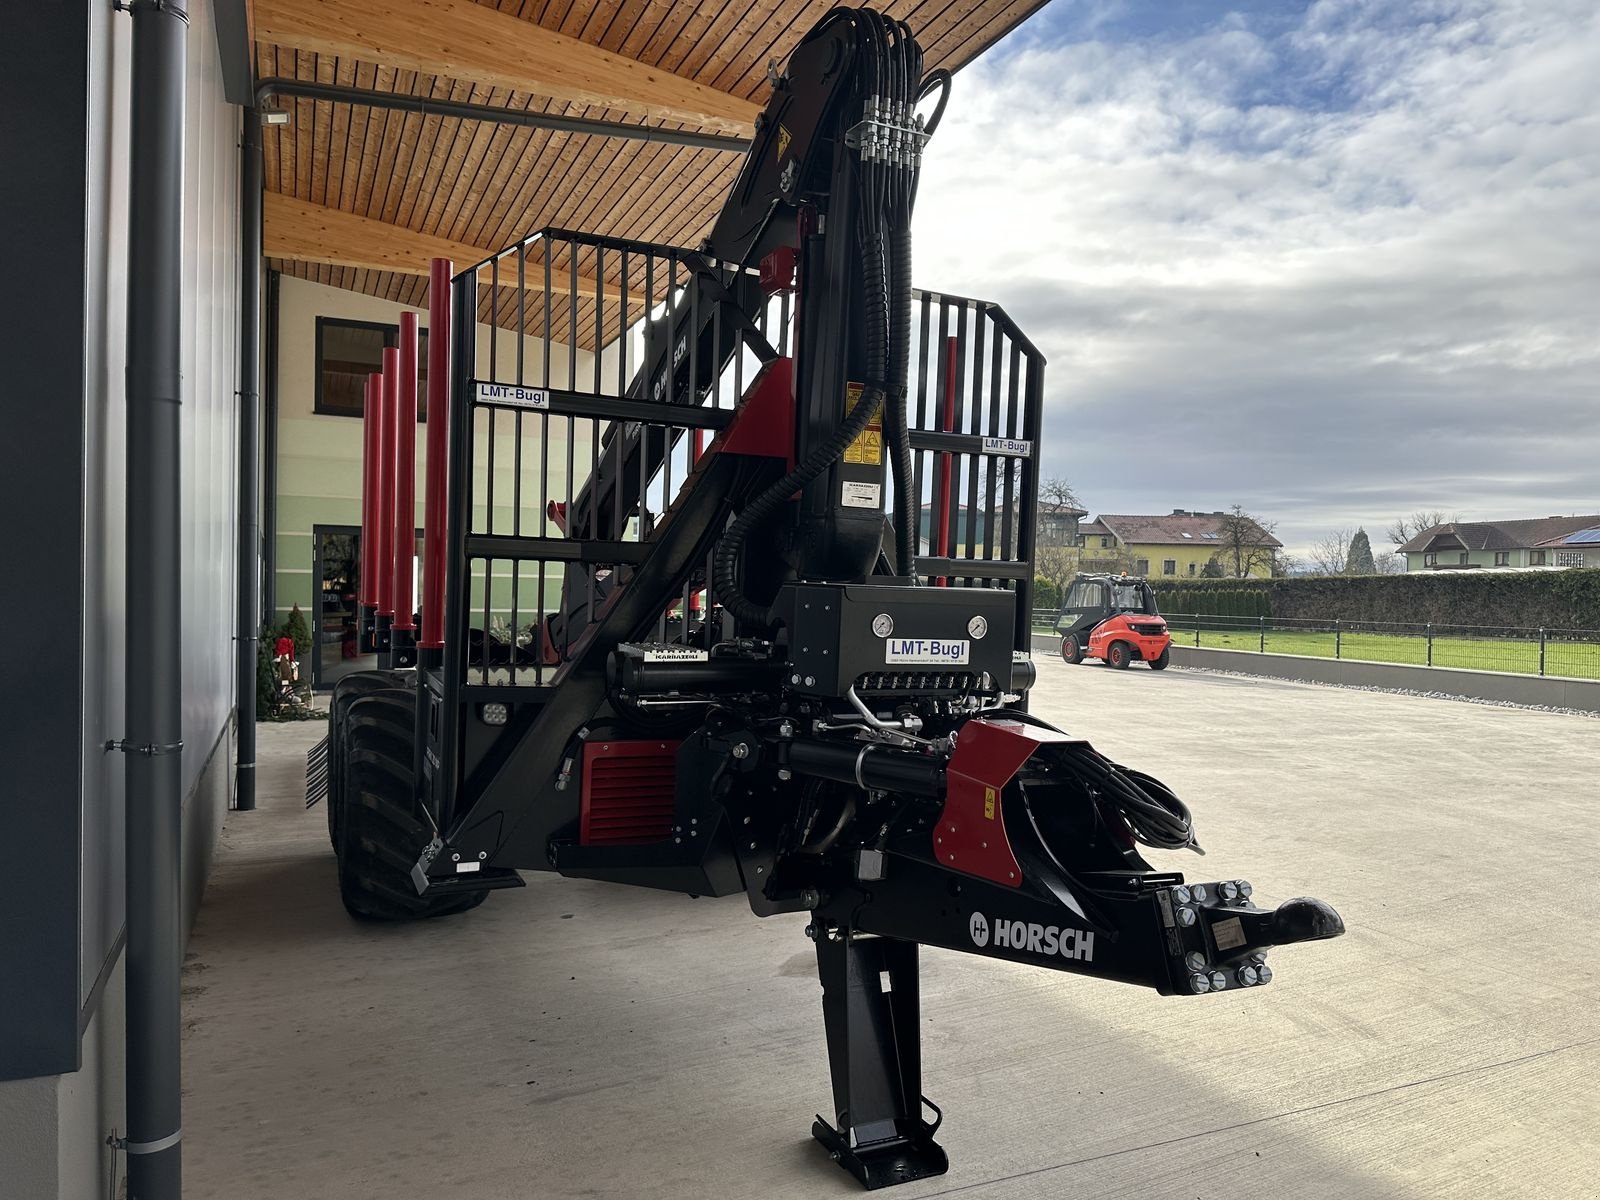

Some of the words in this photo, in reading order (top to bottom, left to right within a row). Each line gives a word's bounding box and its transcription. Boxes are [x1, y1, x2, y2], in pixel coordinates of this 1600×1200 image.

[481, 385, 545, 404] LMT-Bugl
[985, 438, 1028, 453] LMT-Bugl
[891, 640, 965, 659] LMT-Bugl
[994, 918, 1094, 962] HORSCH
